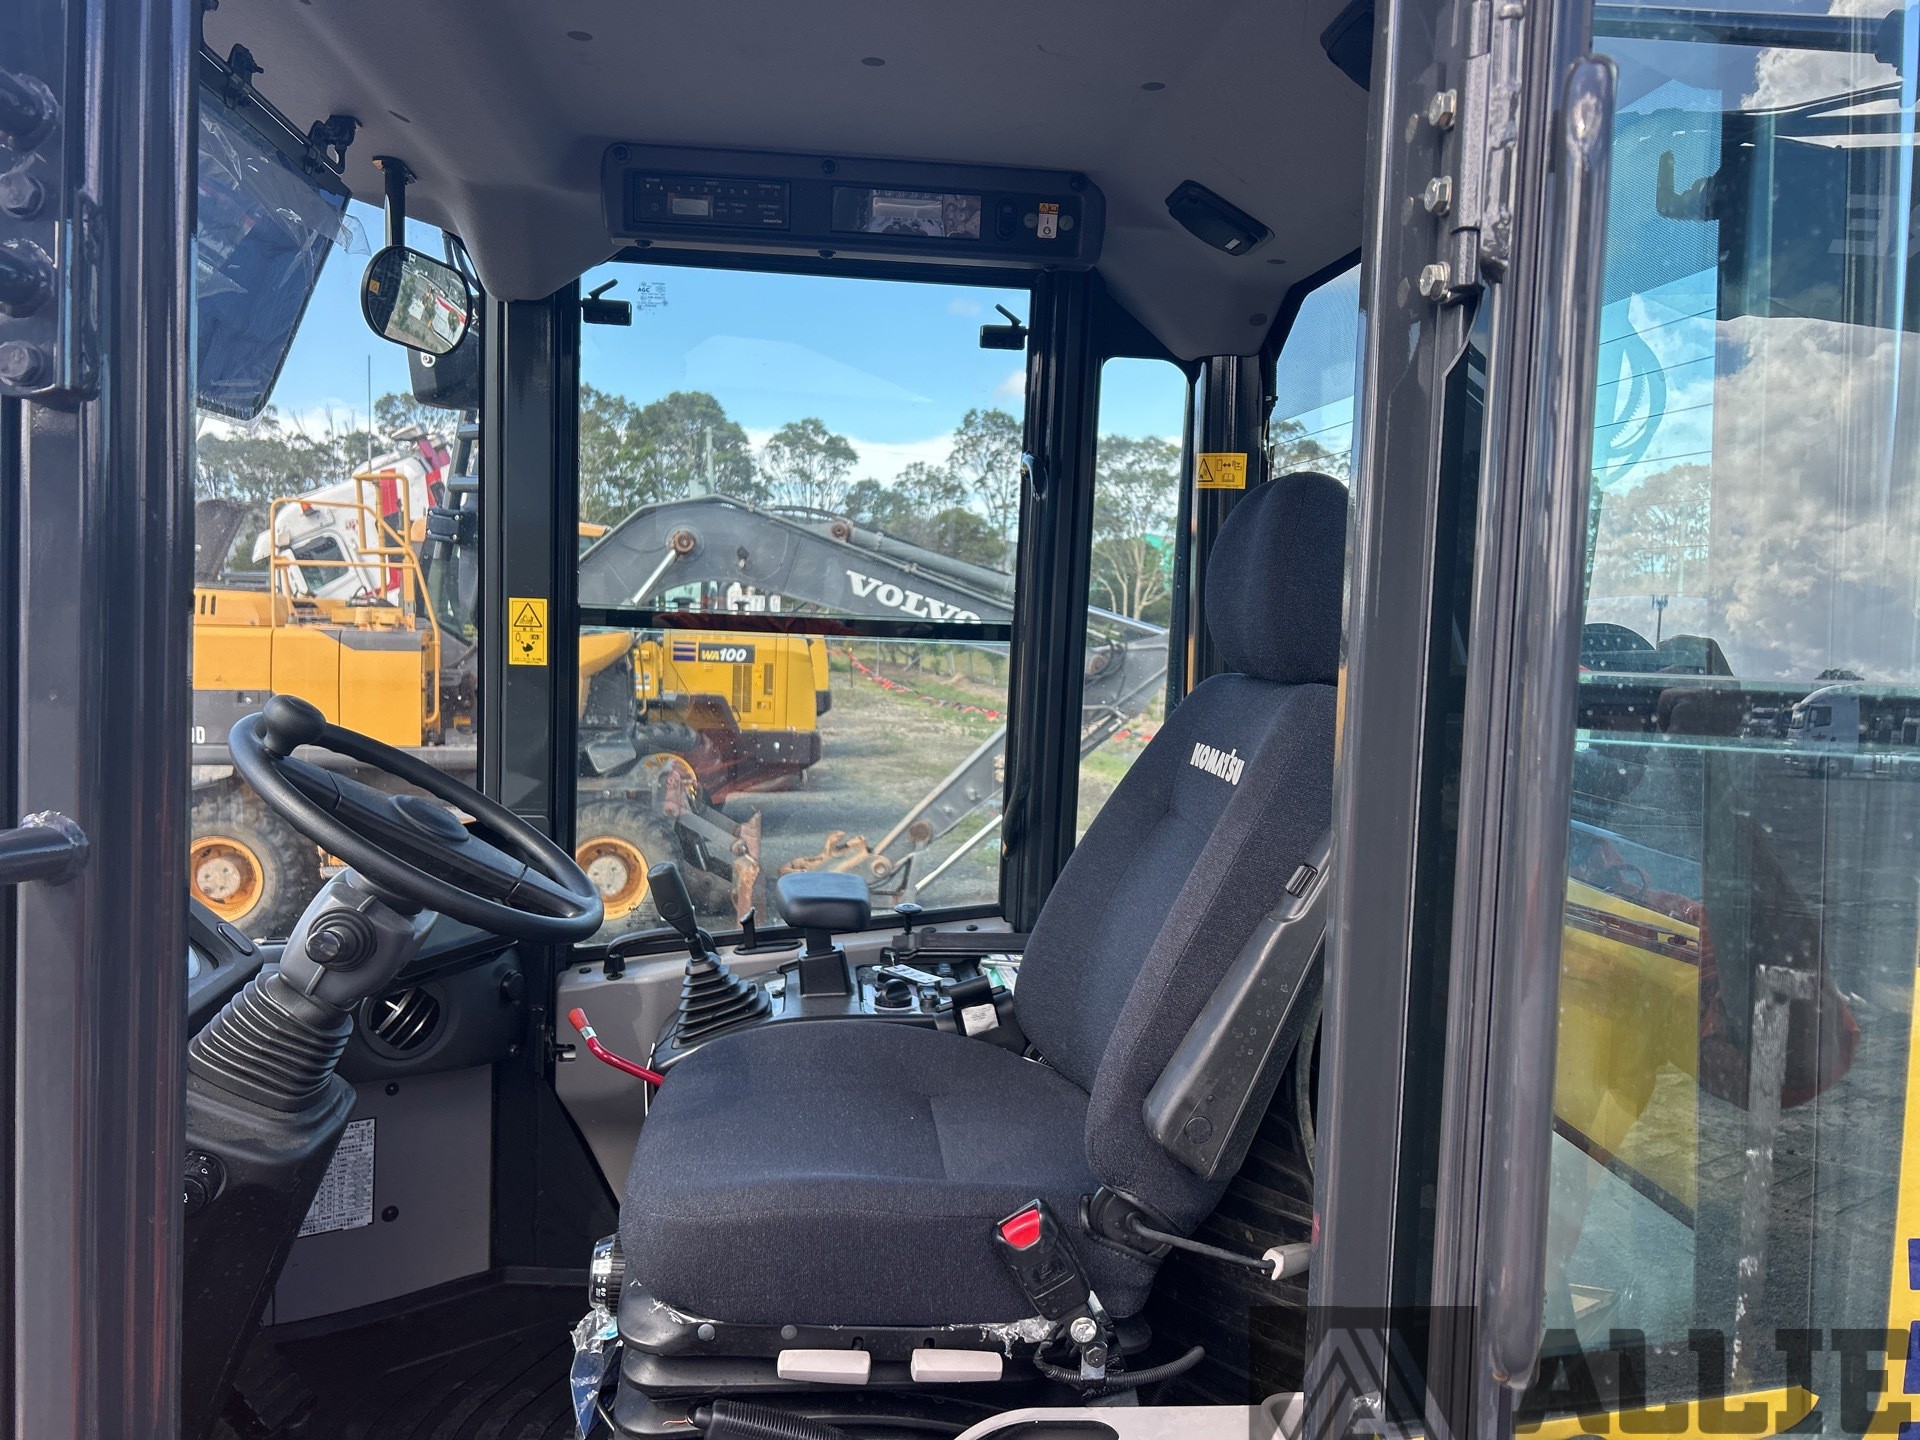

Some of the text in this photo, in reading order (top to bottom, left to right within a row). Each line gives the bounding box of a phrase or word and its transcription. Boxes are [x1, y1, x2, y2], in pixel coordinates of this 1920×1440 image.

[847, 570, 982, 624] VOLVO
[701, 648, 747, 662] WA100
[1190, 742, 1245, 786] KOMATSU
